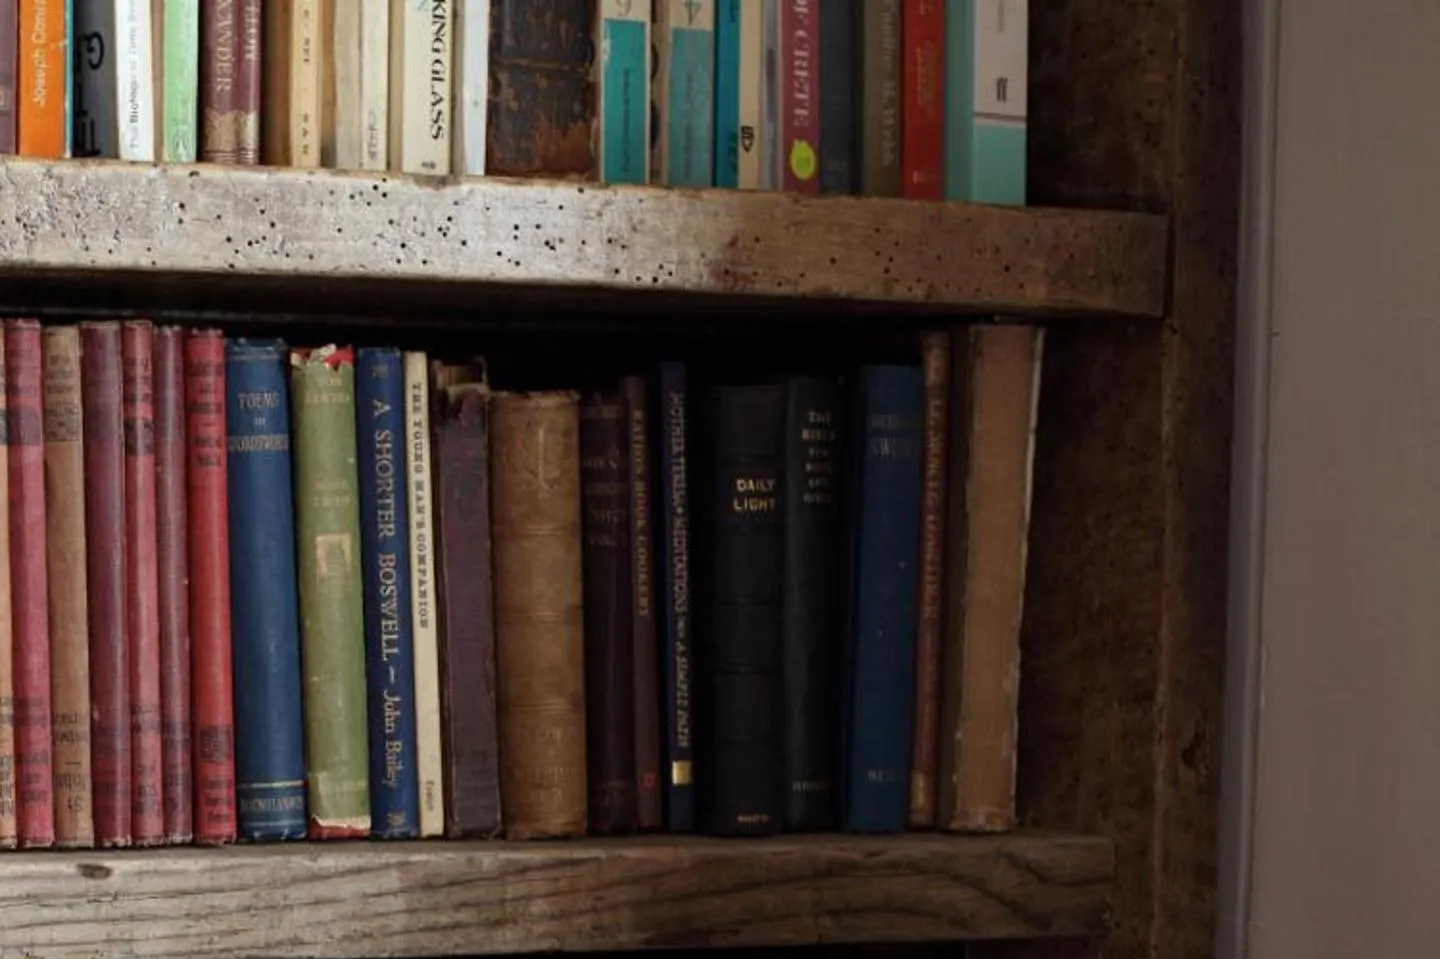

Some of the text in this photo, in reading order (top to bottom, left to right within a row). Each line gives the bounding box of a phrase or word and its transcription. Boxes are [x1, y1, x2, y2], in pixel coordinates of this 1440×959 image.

[32, 48, 47, 108] Joseph
[430, 58, 445, 140] GLASS
[794, 29, 810, 128] CRETE
[411, 383, 429, 629] THE YOUNG MAN'S COMPANION
[733, 497, 775, 512] LIGHT
[736, 478, 777, 492] DAILY
[373, 399, 405, 789] A SHORTER BOSWELL John Bailey
[673, 516, 690, 614] MEDITATIONS
